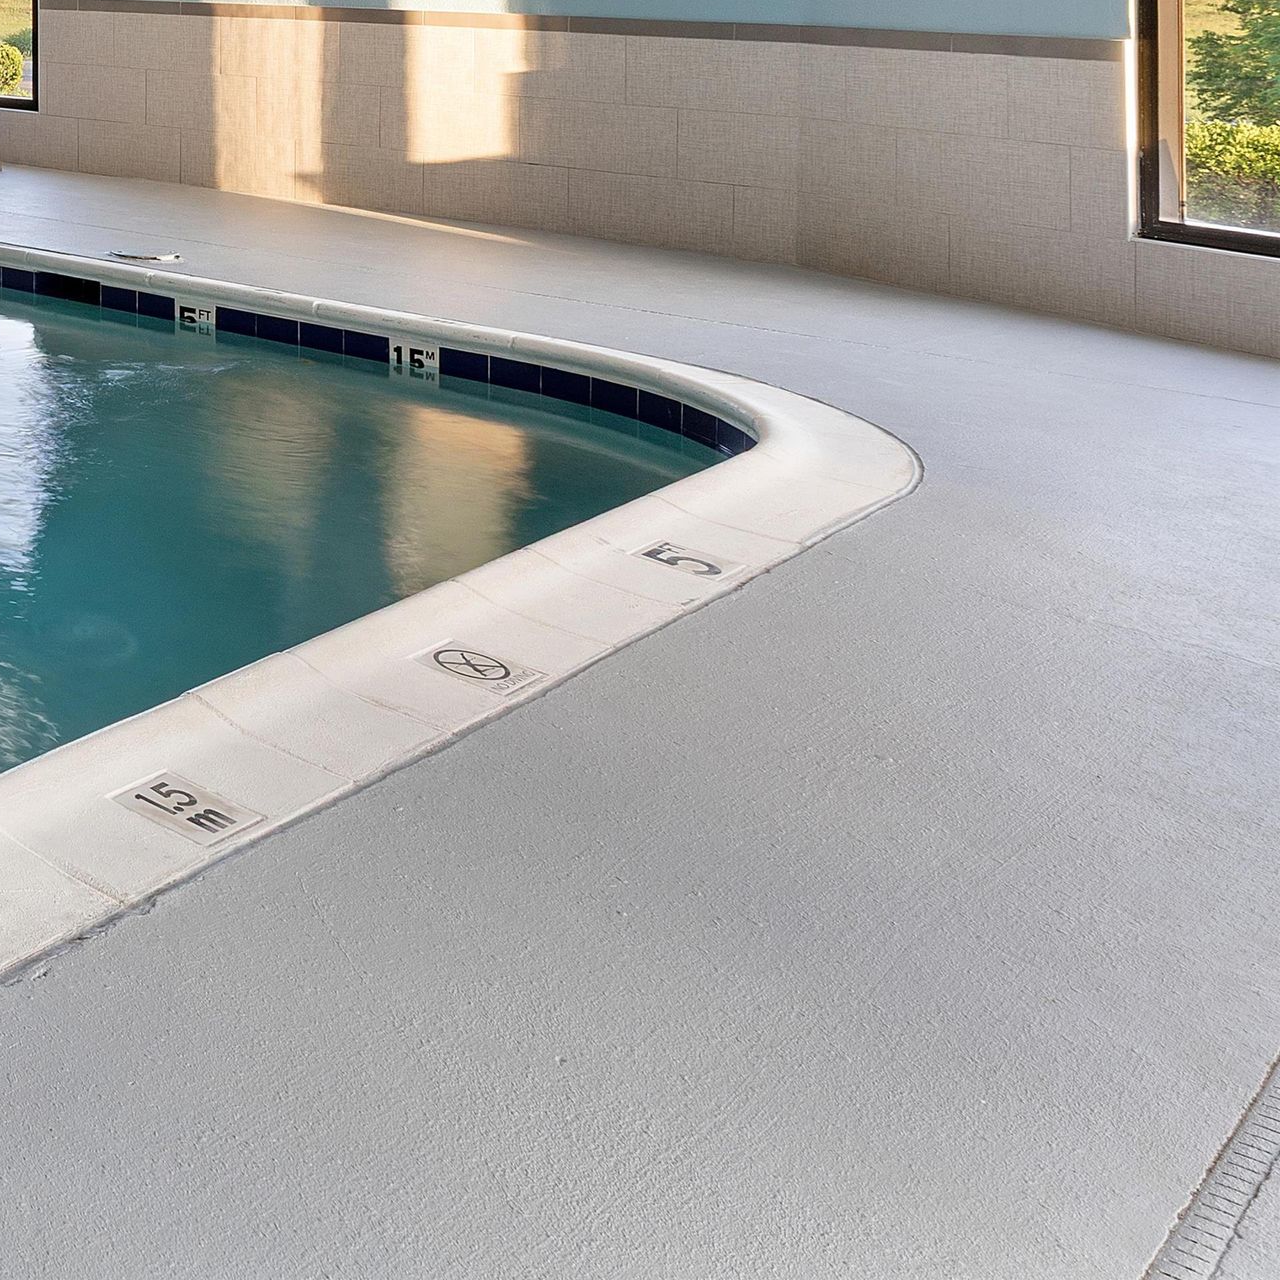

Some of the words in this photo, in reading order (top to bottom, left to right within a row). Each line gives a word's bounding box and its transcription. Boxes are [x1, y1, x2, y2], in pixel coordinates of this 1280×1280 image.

[179, 305, 197, 324] 5
[199, 309, 212, 321] FT
[425, 350, 435, 361] M
[641, 547, 722, 576] 5
[134, 781, 198, 816] 1.5
[185, 808, 237, 834] m
